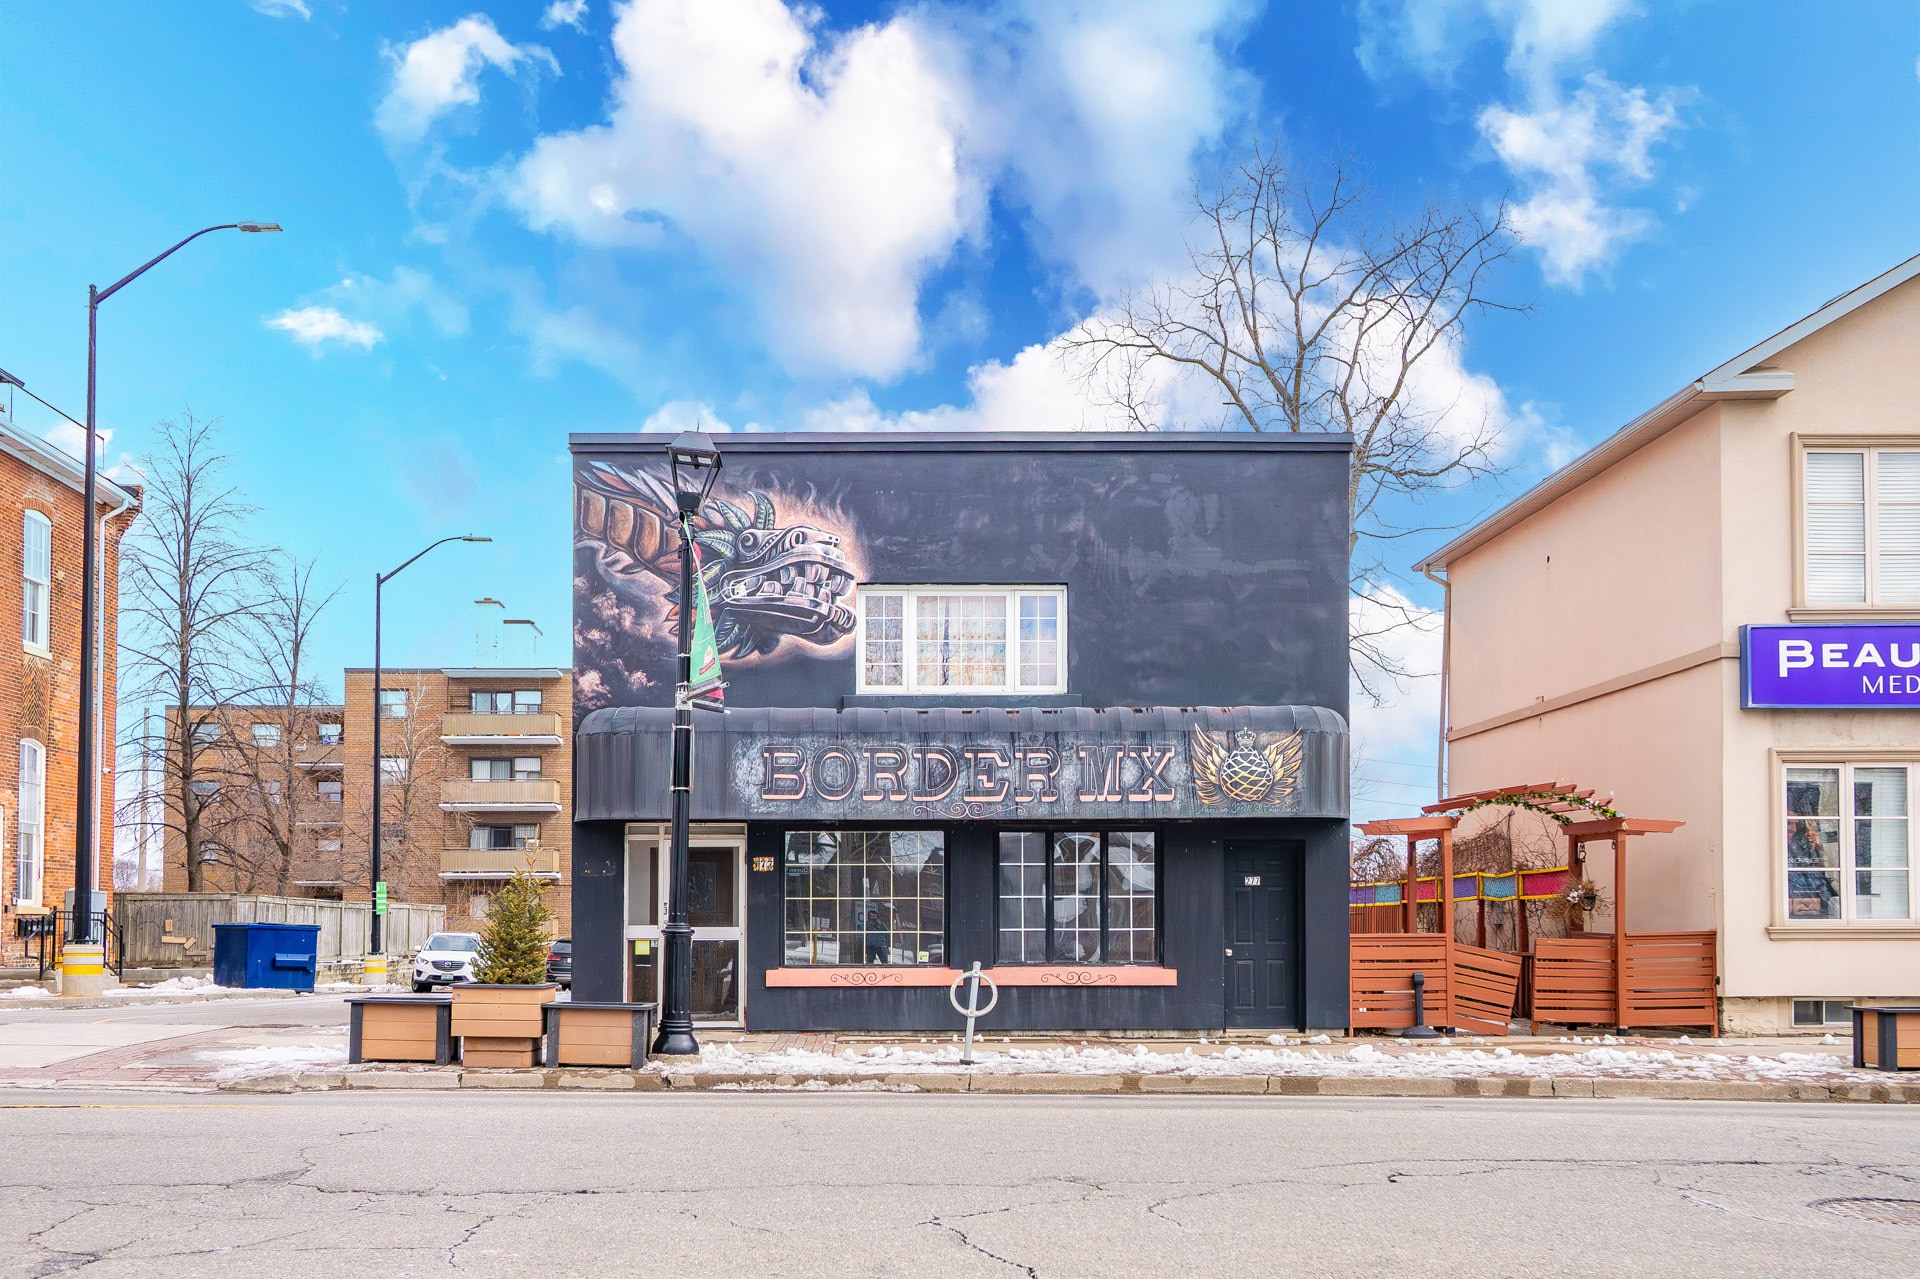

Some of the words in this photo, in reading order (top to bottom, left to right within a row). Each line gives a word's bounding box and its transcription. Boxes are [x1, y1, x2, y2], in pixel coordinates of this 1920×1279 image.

[1779, 640, 1920, 677] BEAU
[1862, 675, 1920, 694] MED
[762, 746, 1060, 802] BORDER
[1079, 746, 1175, 802] MX
[1245, 877, 1260, 885] 277
